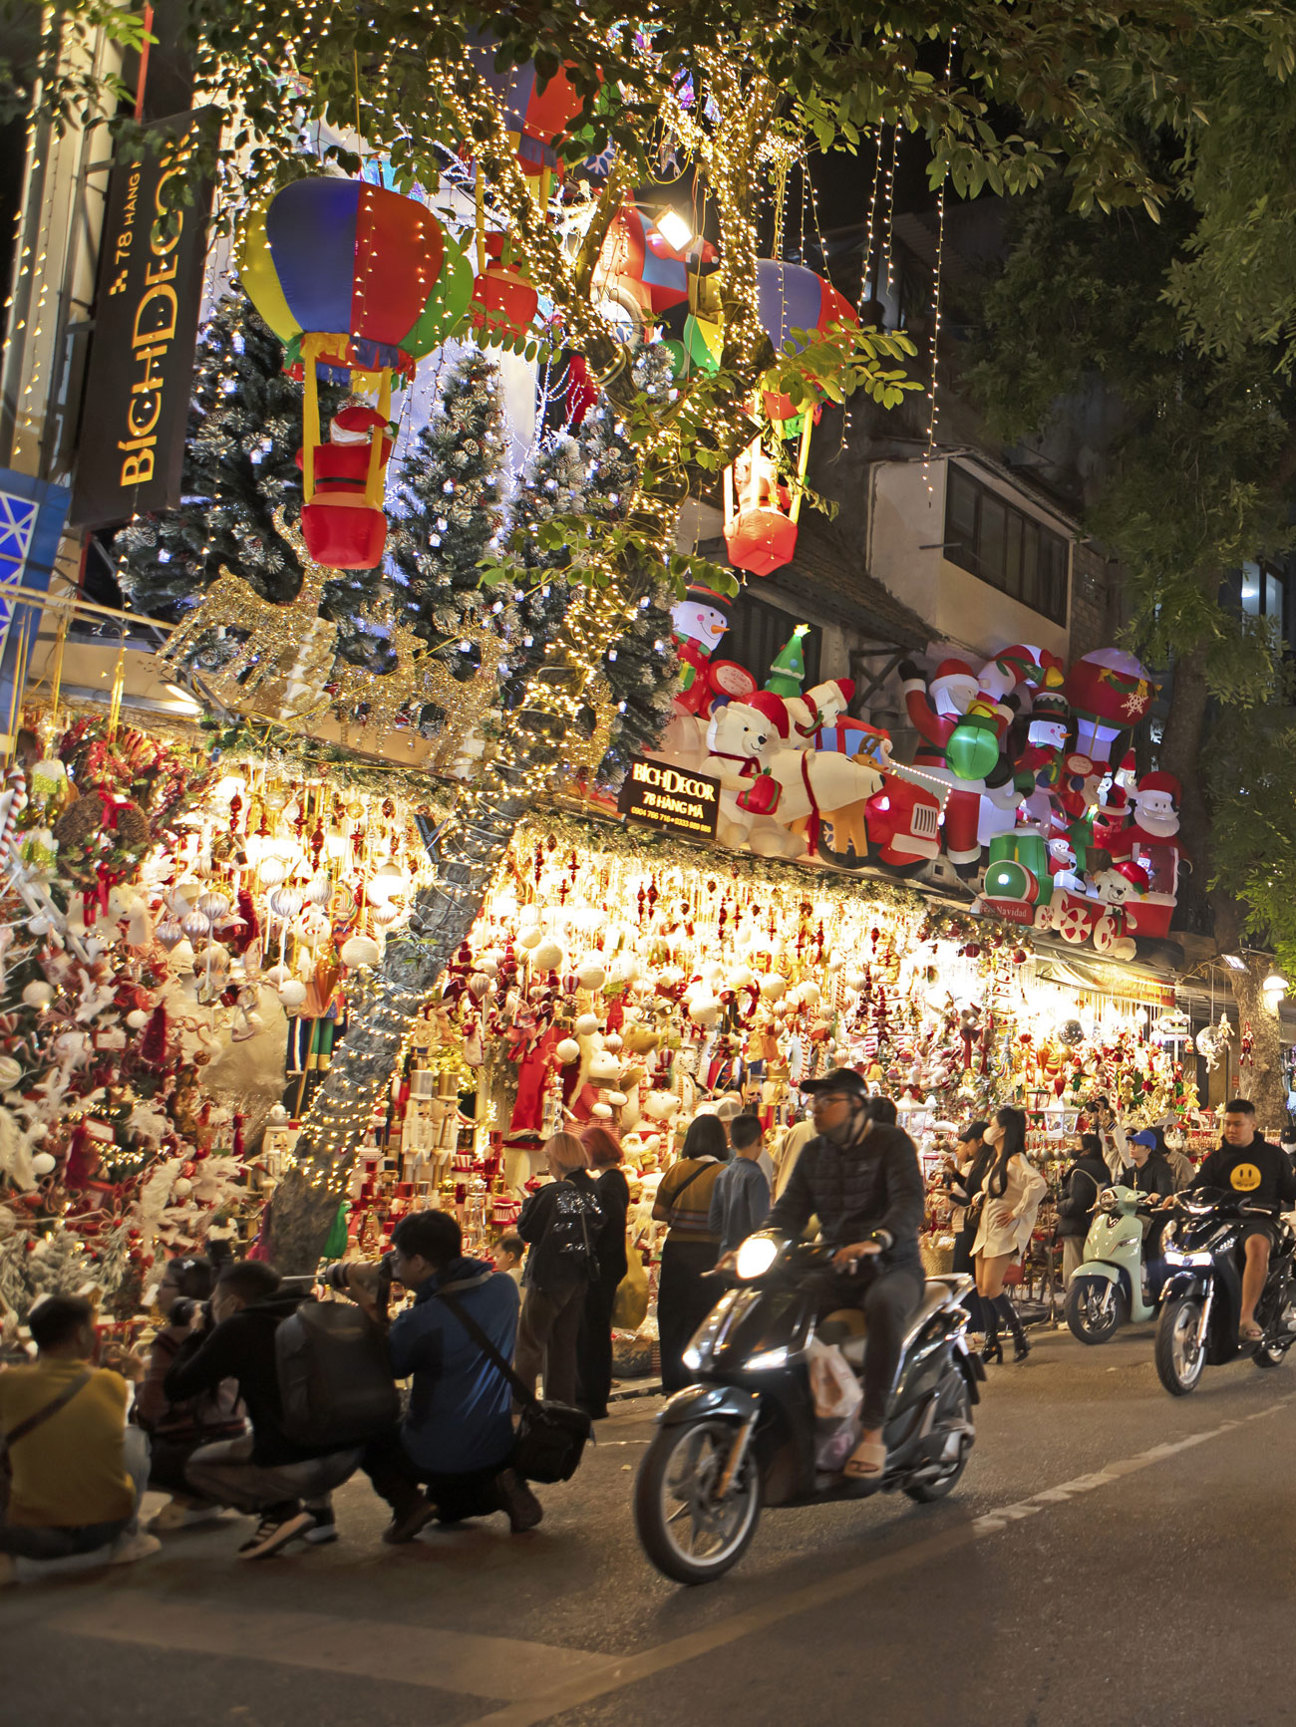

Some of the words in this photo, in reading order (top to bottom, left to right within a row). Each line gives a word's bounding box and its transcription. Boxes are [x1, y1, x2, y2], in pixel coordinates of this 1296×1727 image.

[114, 230, 133, 266] 78
[643, 791, 656, 806] 78
[656, 795, 688, 814] HÀNG
[996, 906, 1027, 918] Navidad
